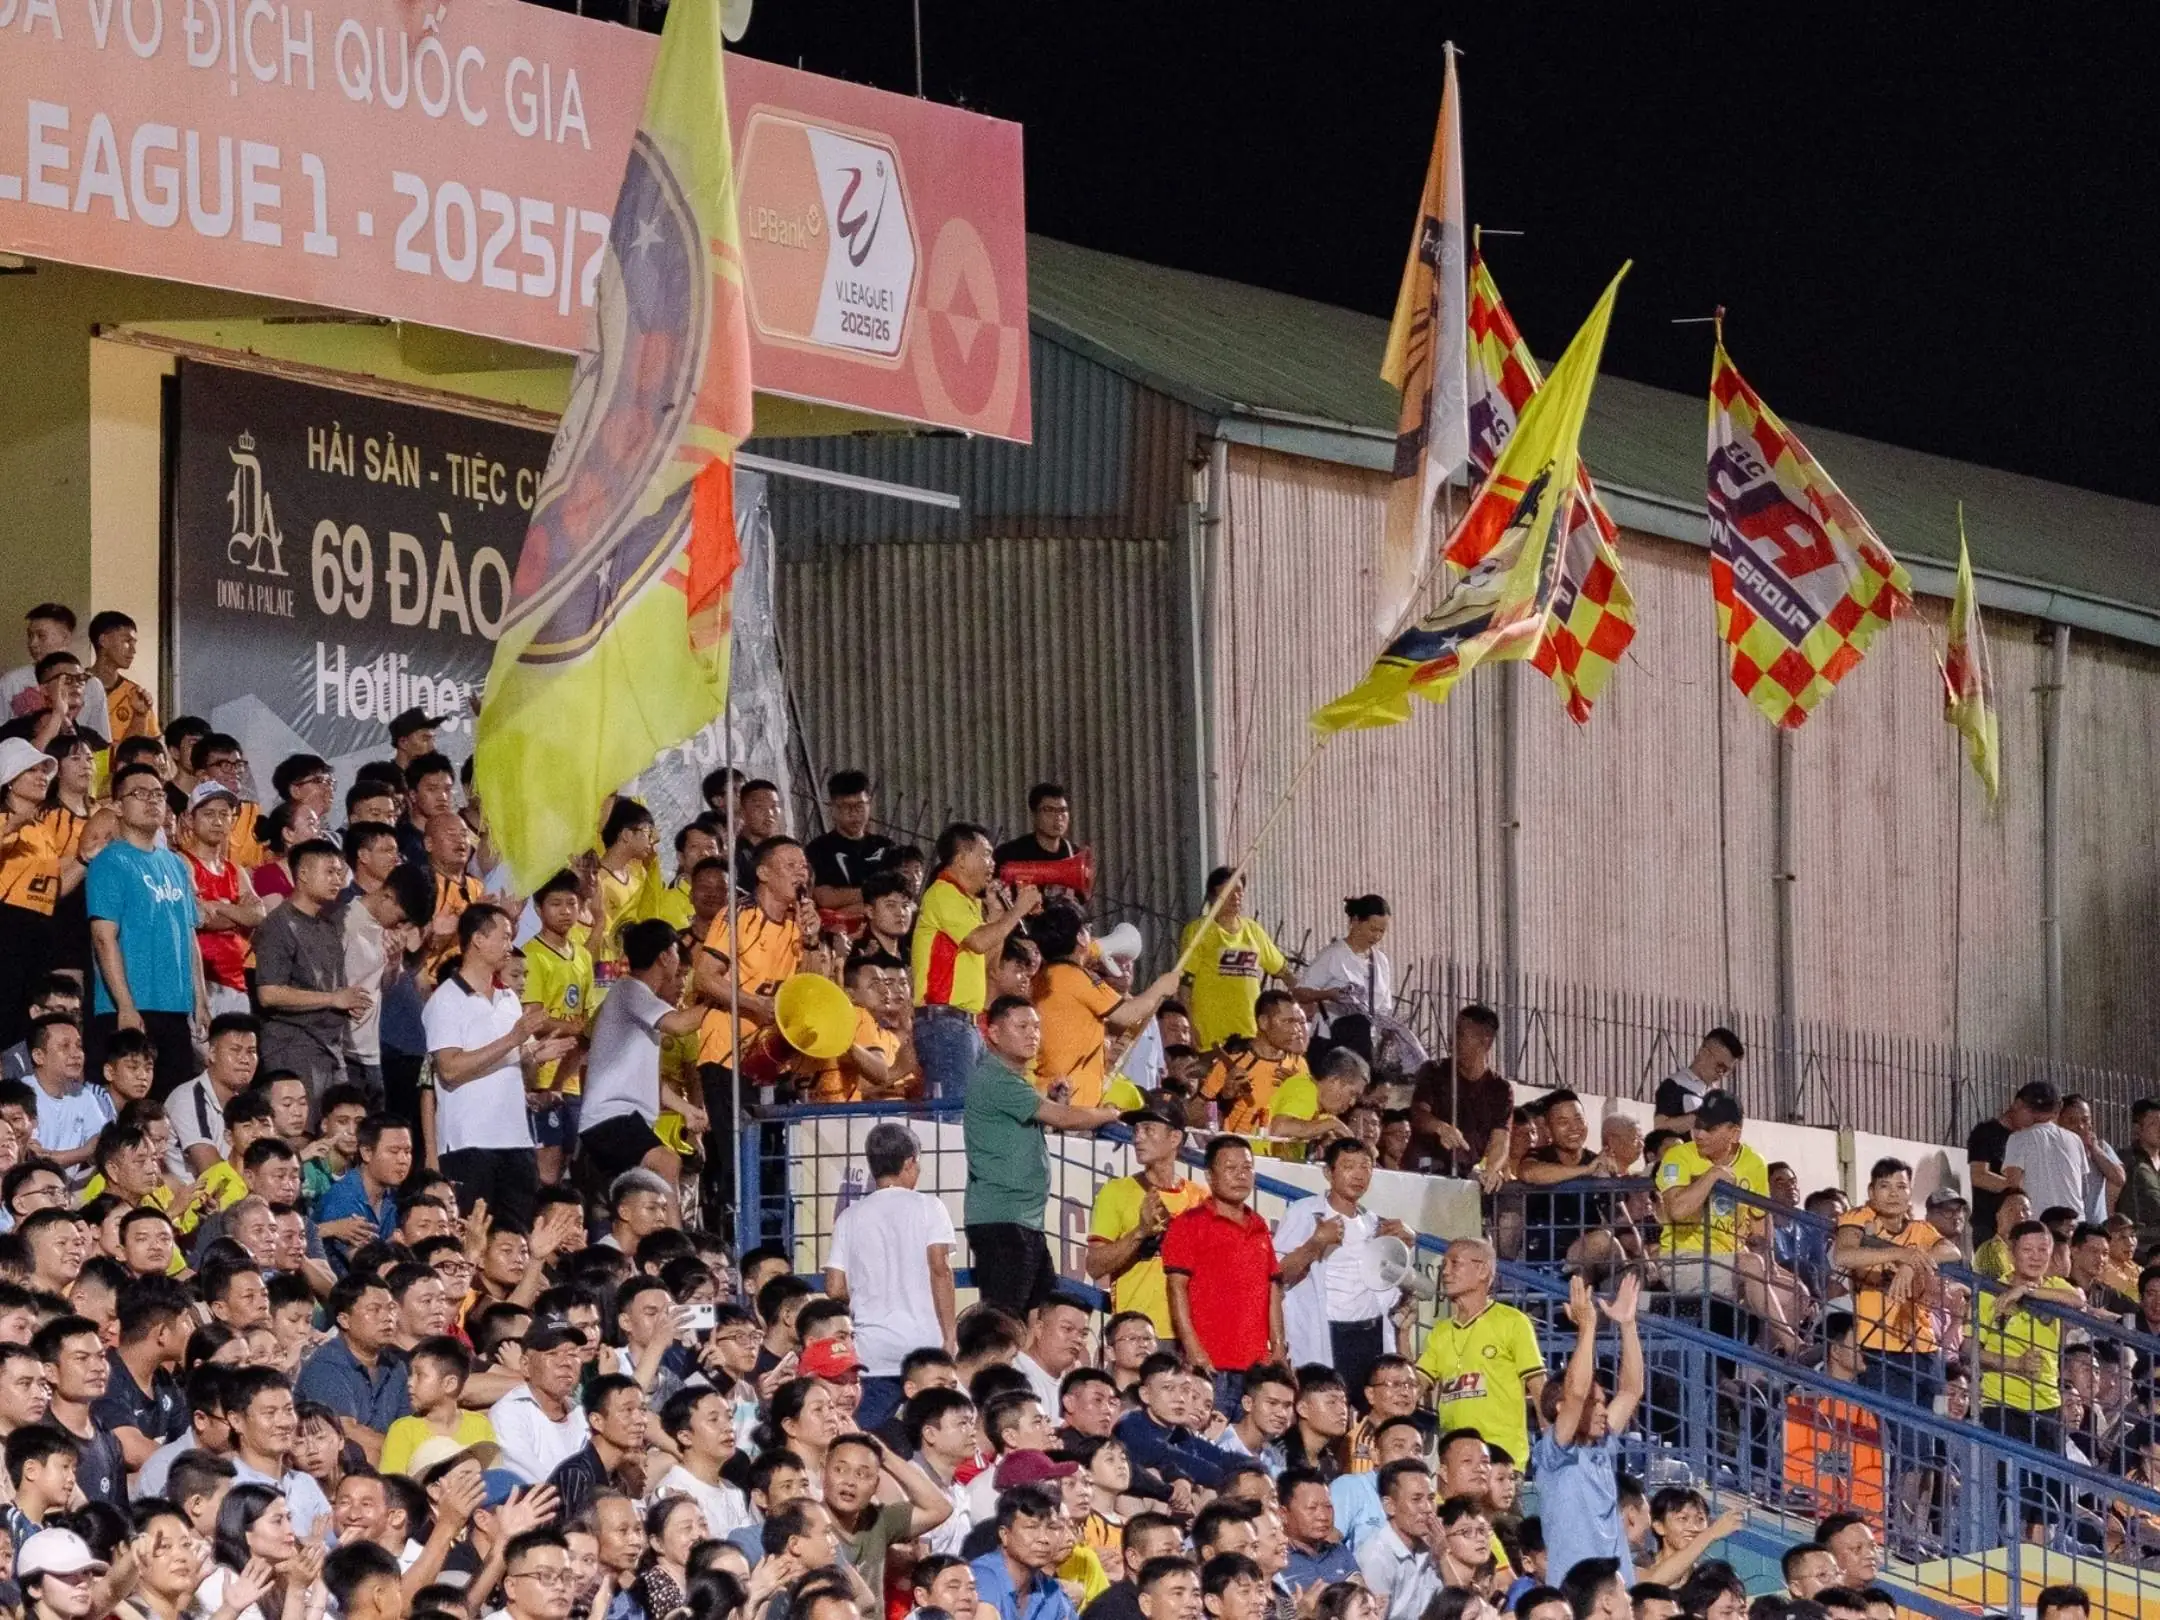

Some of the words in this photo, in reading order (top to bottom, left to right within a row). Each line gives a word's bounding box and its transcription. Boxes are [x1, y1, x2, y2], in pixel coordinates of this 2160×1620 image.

[182, 0, 315, 97] ĐỊCH
[334, 4, 489, 126] QUỐC
[505, 56, 592, 150] GIA
[301, 152, 338, 258] 1
[391, 170, 611, 316] 2025/2
[749, 205, 808, 249] LPBank
[835, 279, 889, 312] V.LEAGUE
[840, 310, 890, 341] 2025/26
[308, 421, 354, 477] HẢI
[364, 432, 420, 489] SẢN
[446, 452, 507, 512] TIỆC
[217, 579, 245, 610] DONG
[247, 583, 255, 612] A
[256, 585, 295, 618] PALACE
[311, 519, 374, 620] 69
[385, 512, 511, 640] ĐÀO
[1732, 555, 1811, 631] GROUP
[316, 641, 473, 734] Hotline:
